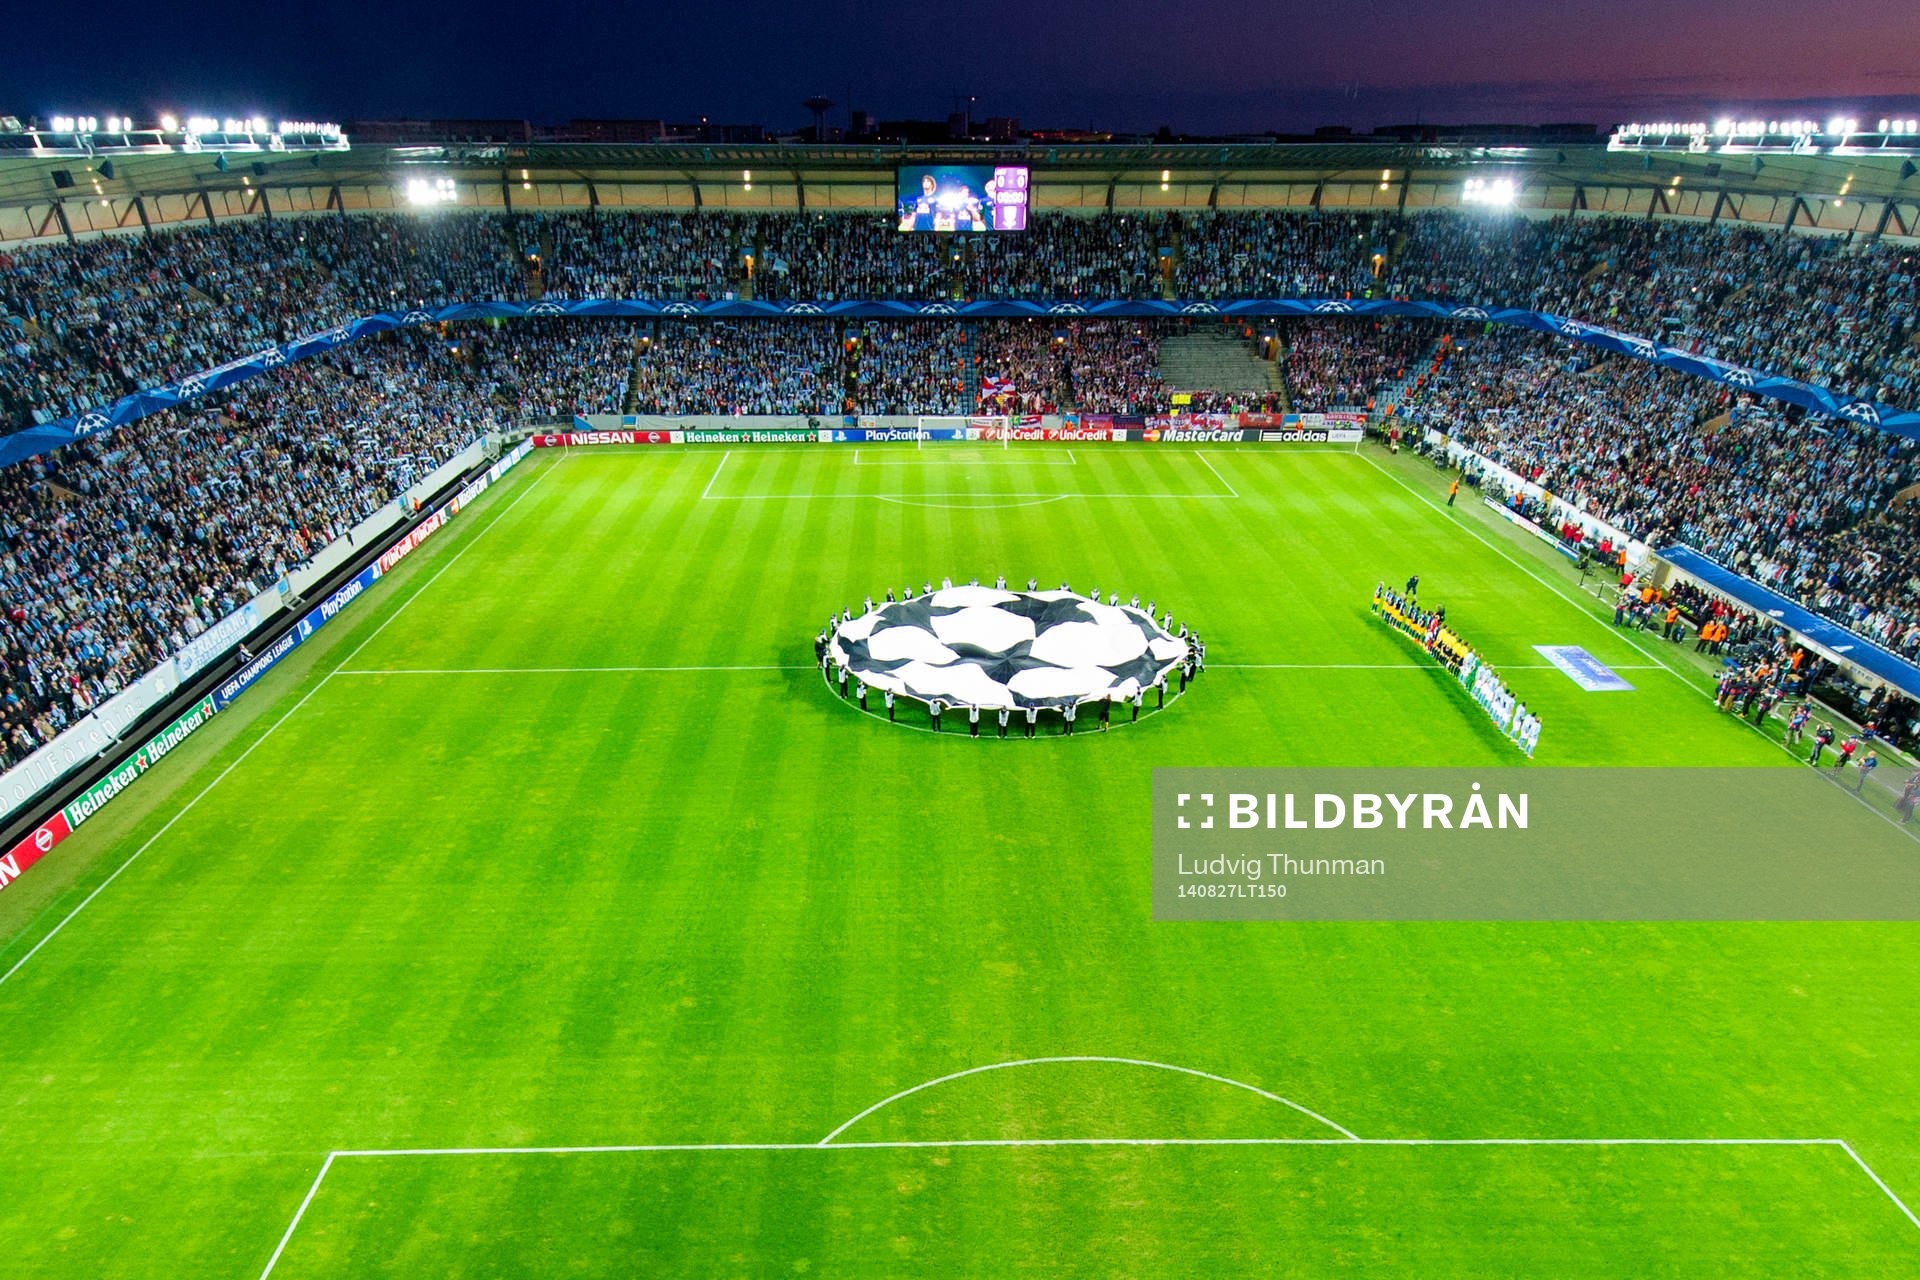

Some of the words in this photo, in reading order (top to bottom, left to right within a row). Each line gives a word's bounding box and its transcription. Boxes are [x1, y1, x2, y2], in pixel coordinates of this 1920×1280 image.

[571, 432, 634, 445] NISSAN
[687, 431, 739, 443] Heineken
[752, 430, 805, 442] Heineken
[866, 429, 930, 441] PlayStation
[996, 429, 1044, 441] UniCredit
[1059, 429, 1107, 441] UniCredit
[1162, 429, 1244, 442] MasterCard
[1283, 430, 1327, 442] adidas
[320, 580, 363, 620] PlayStation
[221, 678, 240, 699] UEFA
[238, 651, 273, 687] CHAMPIONS
[272, 634, 295, 661] LEAGUE
[146, 709, 204, 764] Heineken
[68, 762, 137, 826] Heineken
